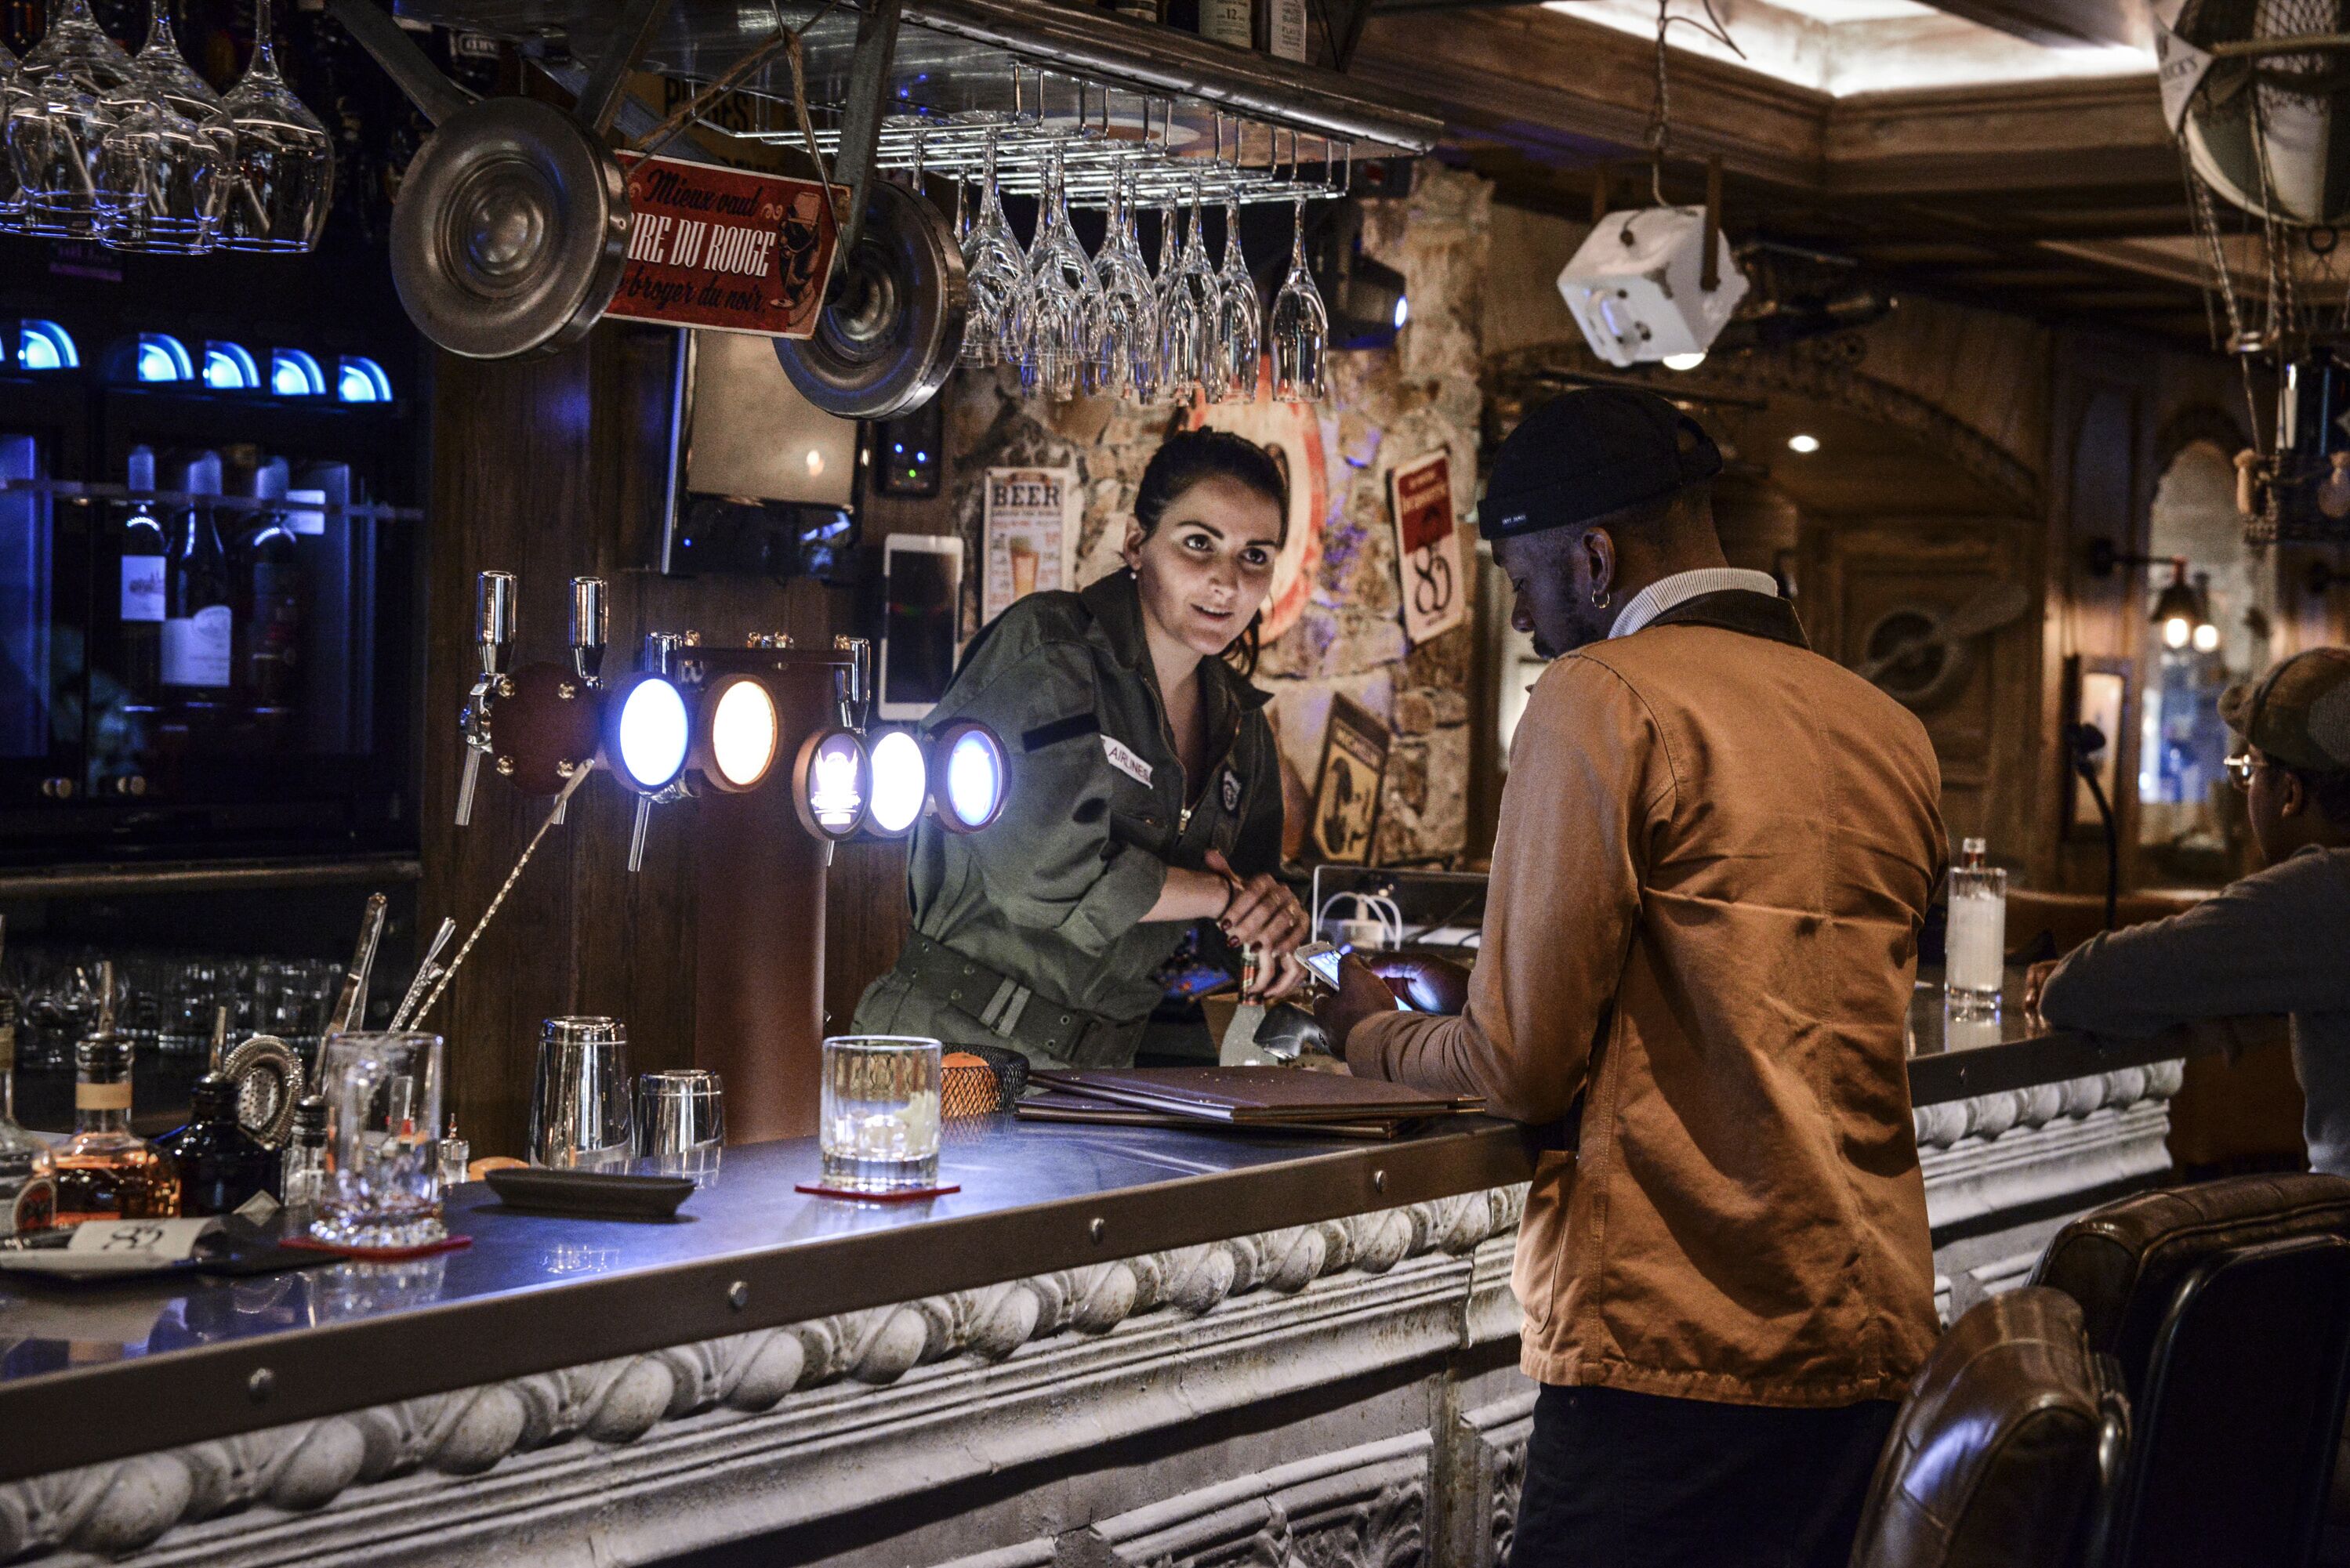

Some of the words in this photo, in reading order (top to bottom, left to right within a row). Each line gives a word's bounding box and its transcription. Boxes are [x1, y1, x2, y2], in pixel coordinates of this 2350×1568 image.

[1226, 9, 1237, 20] 12
[644, 168, 716, 212] Mieux
[716, 185, 765, 218] vaut
[668, 218, 709, 269] DU
[702, 223, 778, 277] ROUGE
[627, 264, 694, 310] broyer
[697, 274, 723, 309] du
[992, 484, 1060, 506] BEER
[1108, 746, 1151, 781] AIRLINES
